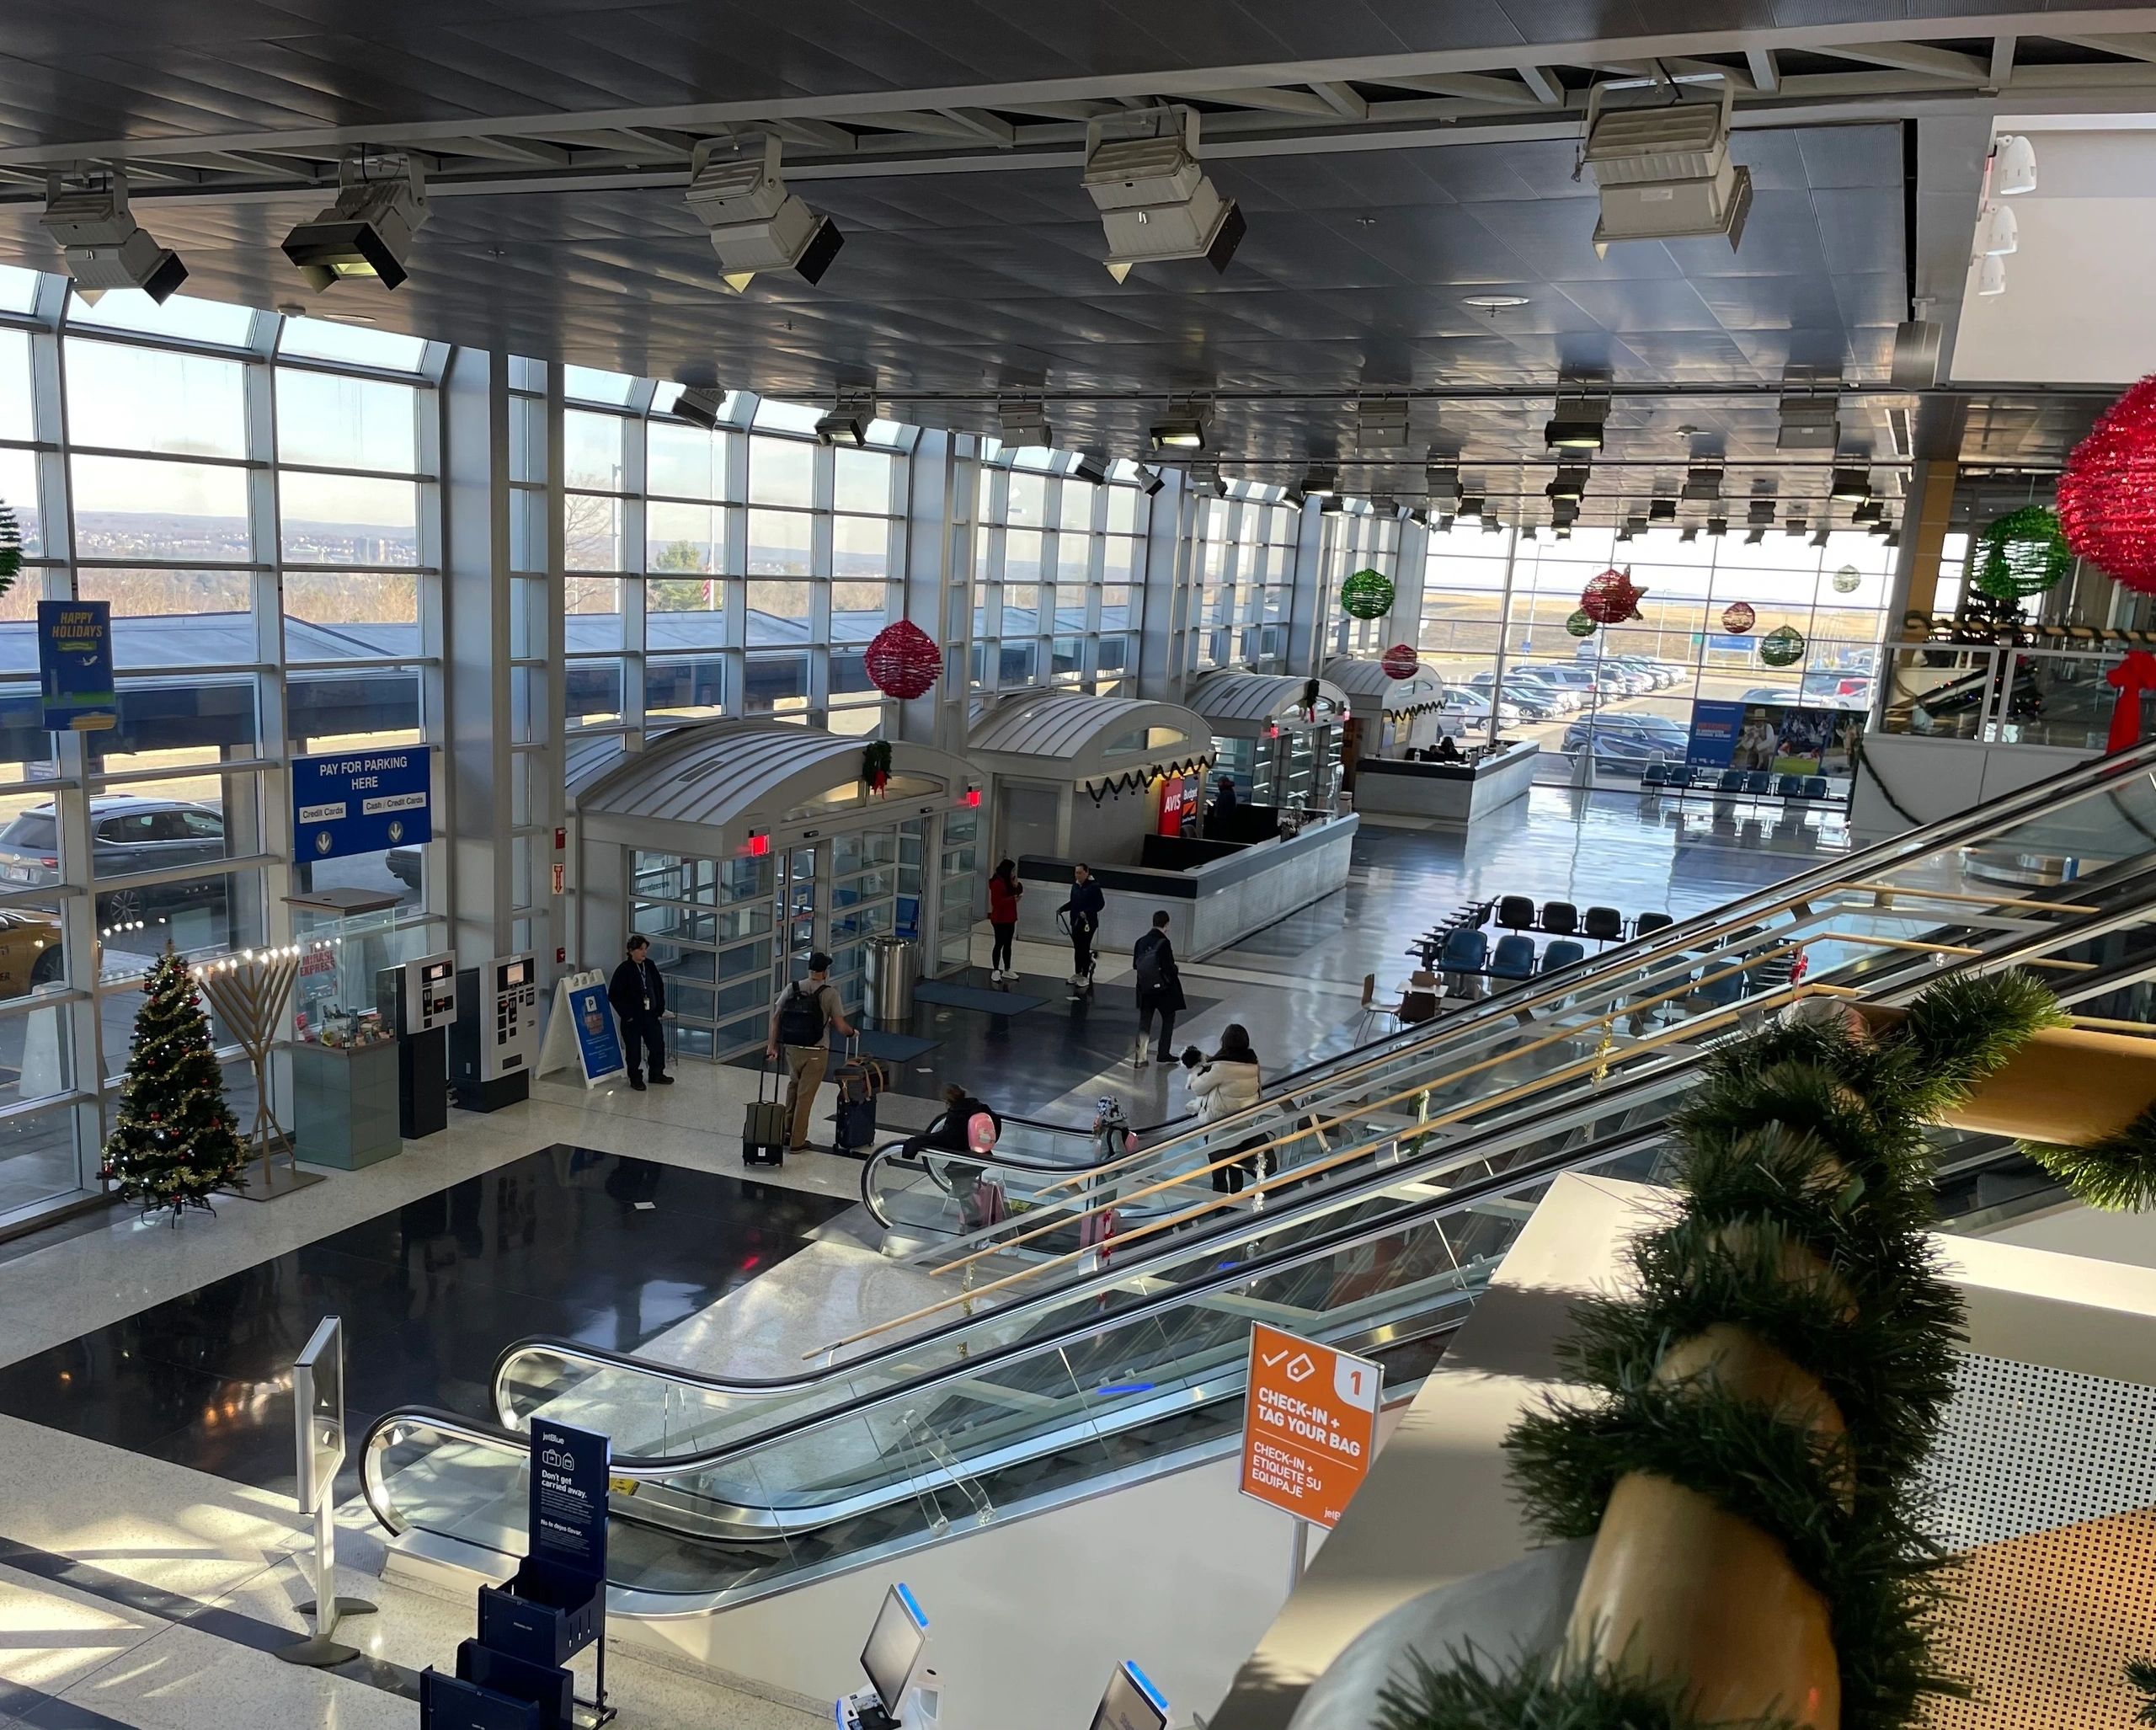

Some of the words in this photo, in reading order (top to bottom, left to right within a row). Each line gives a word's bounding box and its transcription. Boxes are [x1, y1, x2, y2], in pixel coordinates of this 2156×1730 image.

[61, 611, 93, 624] HAPPY
[52, 625, 103, 638] HOLIDAYS
[320, 763, 339, 776] PAY
[341, 761, 362, 774] FOR
[364, 756, 408, 772] PARKING
[351, 776, 378, 790] HERE
[366, 801, 382, 810] Cash
[387, 798, 405, 808] Credit
[406, 796, 424, 805] Cards
[1164, 793, 1181, 814] AVIS
[302, 809, 323, 819] Credit
[324, 806, 344, 816] Cards
[1350, 1370, 1362, 1396] 1
[1258, 1386, 1328, 1423] CHECK-IN
[542, 1431, 565, 1444] jetBlue
[1257, 1404, 1284, 1427] TAG
[1287, 1417, 1326, 1445] YOUR
[1329, 1433, 1361, 1457] BAG
[1254, 1441, 1305, 1471] CHECK-IN
[542, 1470, 559, 1482] Don't
[560, 1476, 572, 1485] get
[1252, 1455, 1305, 1485] ETIQUETE
[1305, 1476, 1321, 1492] SU
[541, 1480, 567, 1492] carried
[567, 1487, 587, 1498] away.
[1251, 1468, 1304, 1498] EQUIPAJE
[1324, 1507, 1342, 1521] jetB
